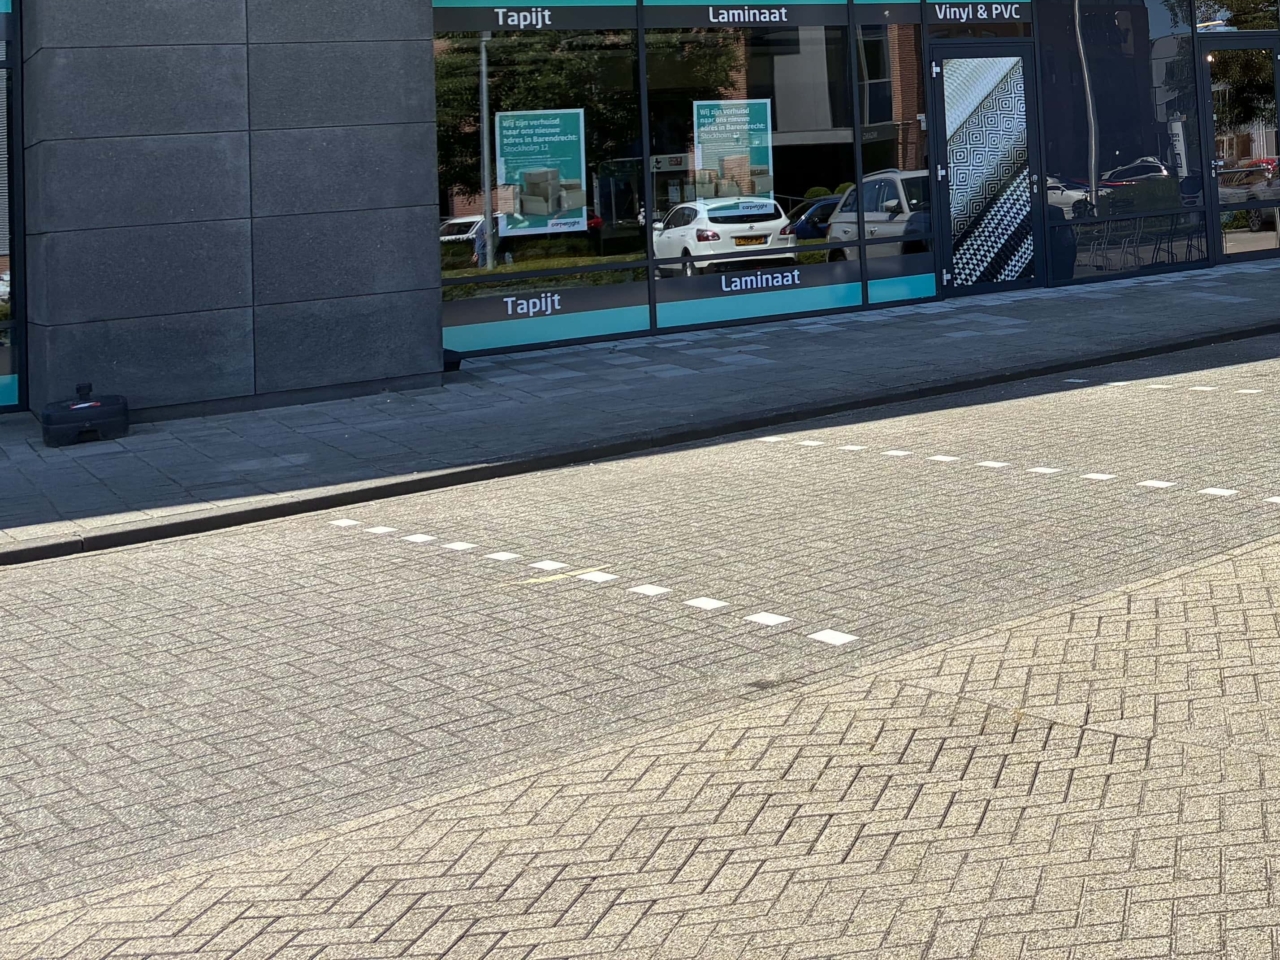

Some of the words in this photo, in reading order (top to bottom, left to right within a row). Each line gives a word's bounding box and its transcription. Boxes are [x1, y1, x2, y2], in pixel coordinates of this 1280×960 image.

[494, 7, 552, 30] Tapijt
[708, 5, 788, 24] Laminaat
[935, 3, 973, 22] Vinyl
[978, 4, 989, 19] &
[992, 3, 1020, 19] PVC
[720, 269, 801, 292] Laminaat
[503, 292, 562, 316] Tapijt
